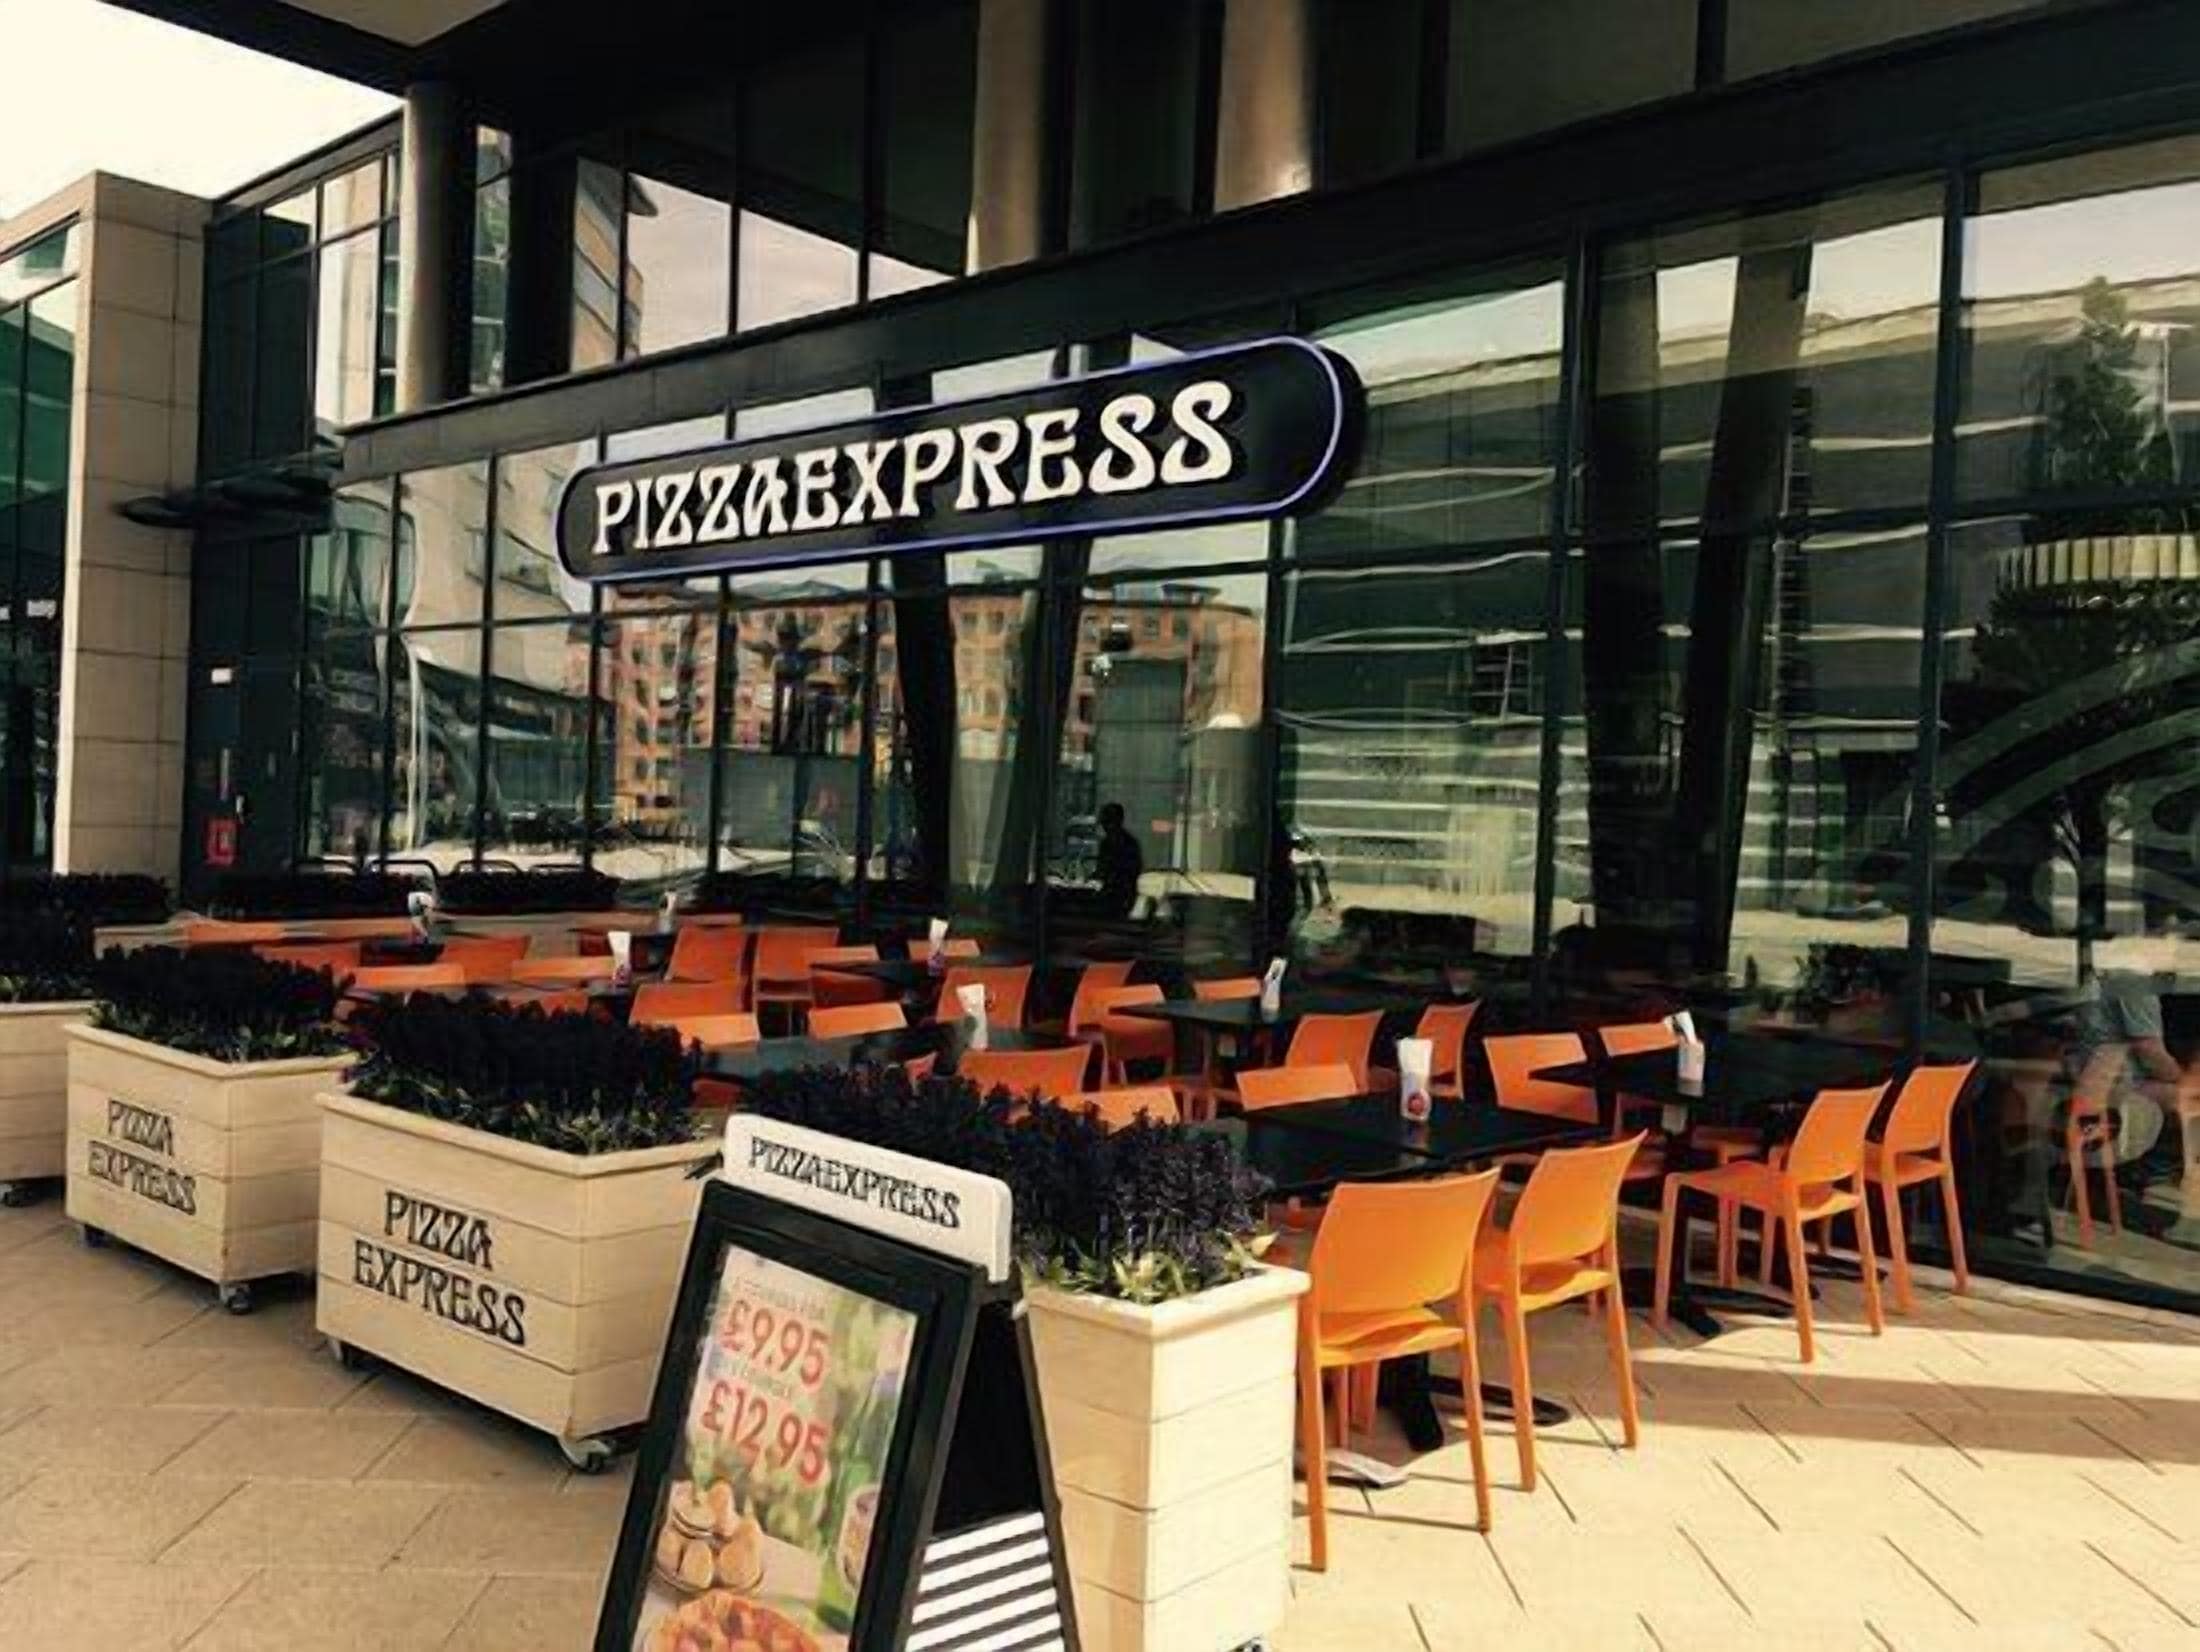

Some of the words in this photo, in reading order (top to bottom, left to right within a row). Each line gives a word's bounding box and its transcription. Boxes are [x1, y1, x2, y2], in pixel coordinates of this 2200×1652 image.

[592, 380, 1232, 555] PIZZAEXPRESS
[107, 1098, 174, 1156] PIZZA
[88, 1139, 196, 1216] EXPRESS
[750, 1136, 960, 1228] PIZZAEXPRESS
[385, 1190, 492, 1271] PIZZA
[354, 1239, 525, 1346] EXPRESS
[721, 1300, 829, 1385] £9.95
[701, 1379, 828, 1484] £12.95
